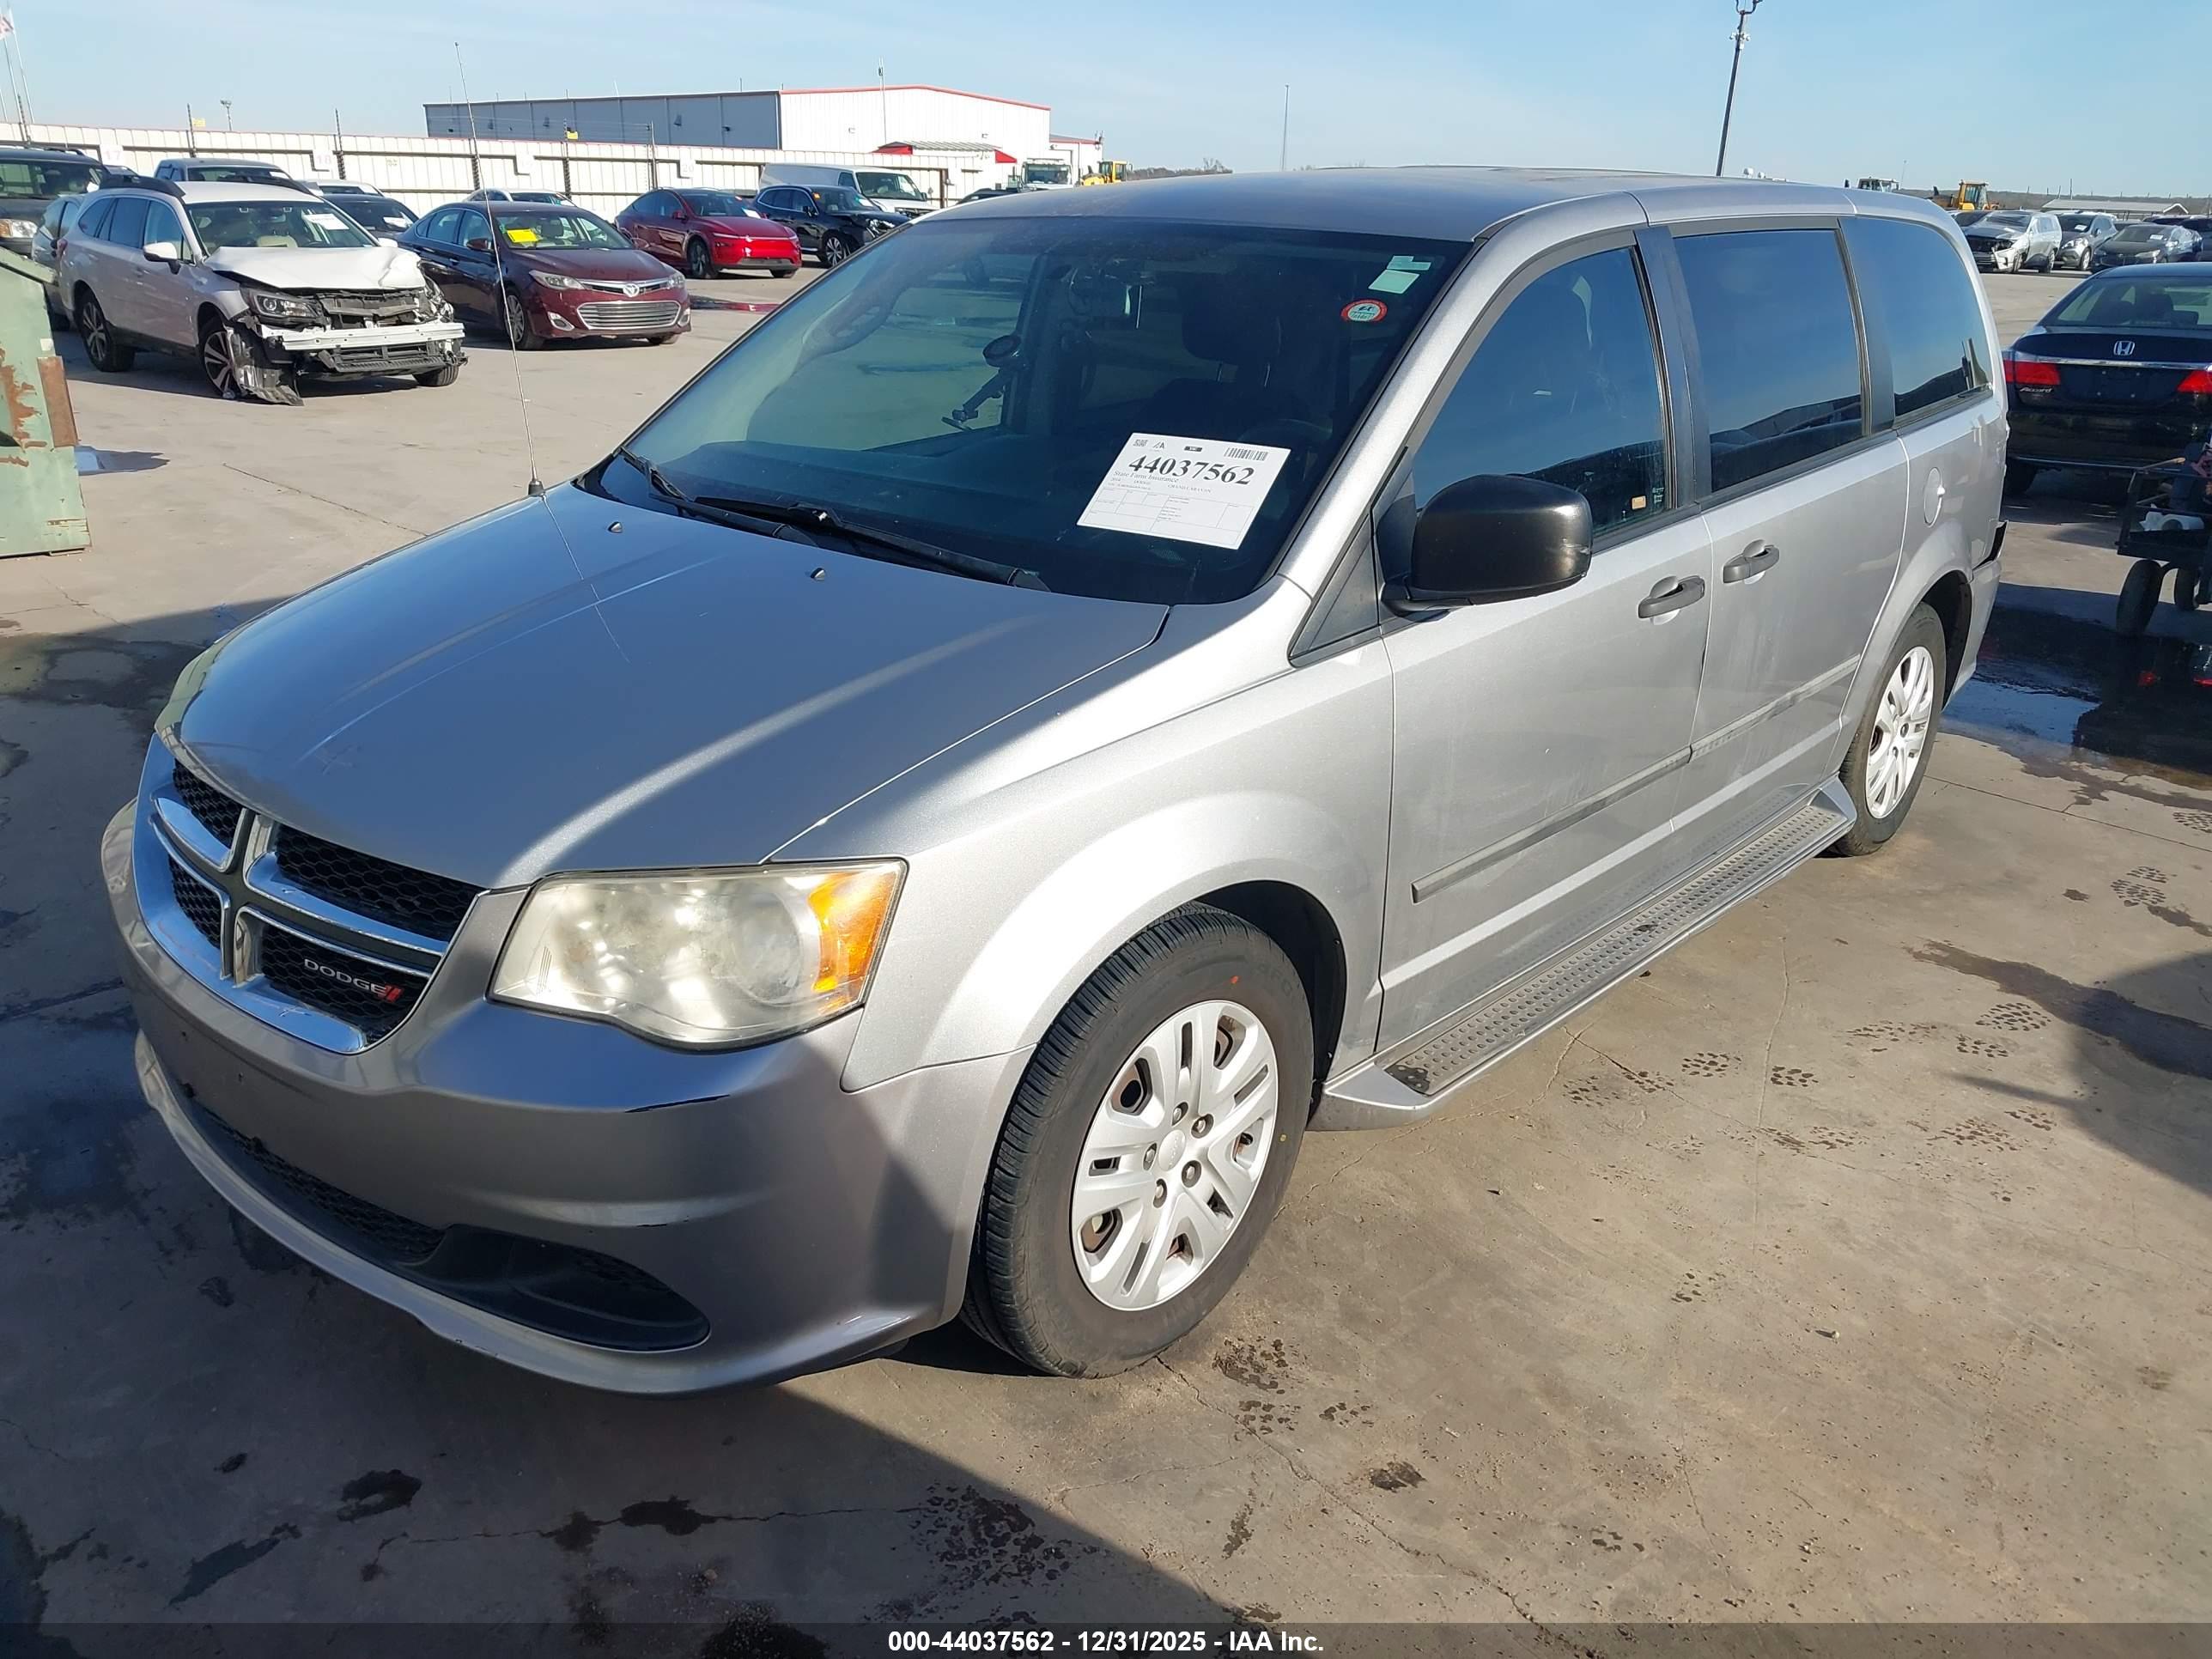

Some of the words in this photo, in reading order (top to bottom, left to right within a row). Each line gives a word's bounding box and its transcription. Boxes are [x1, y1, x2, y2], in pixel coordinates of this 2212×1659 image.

[1128, 454, 1255, 485] 44037562
[1147, 474, 1181, 483] Insurance
[304, 958, 387, 995] DODGE
